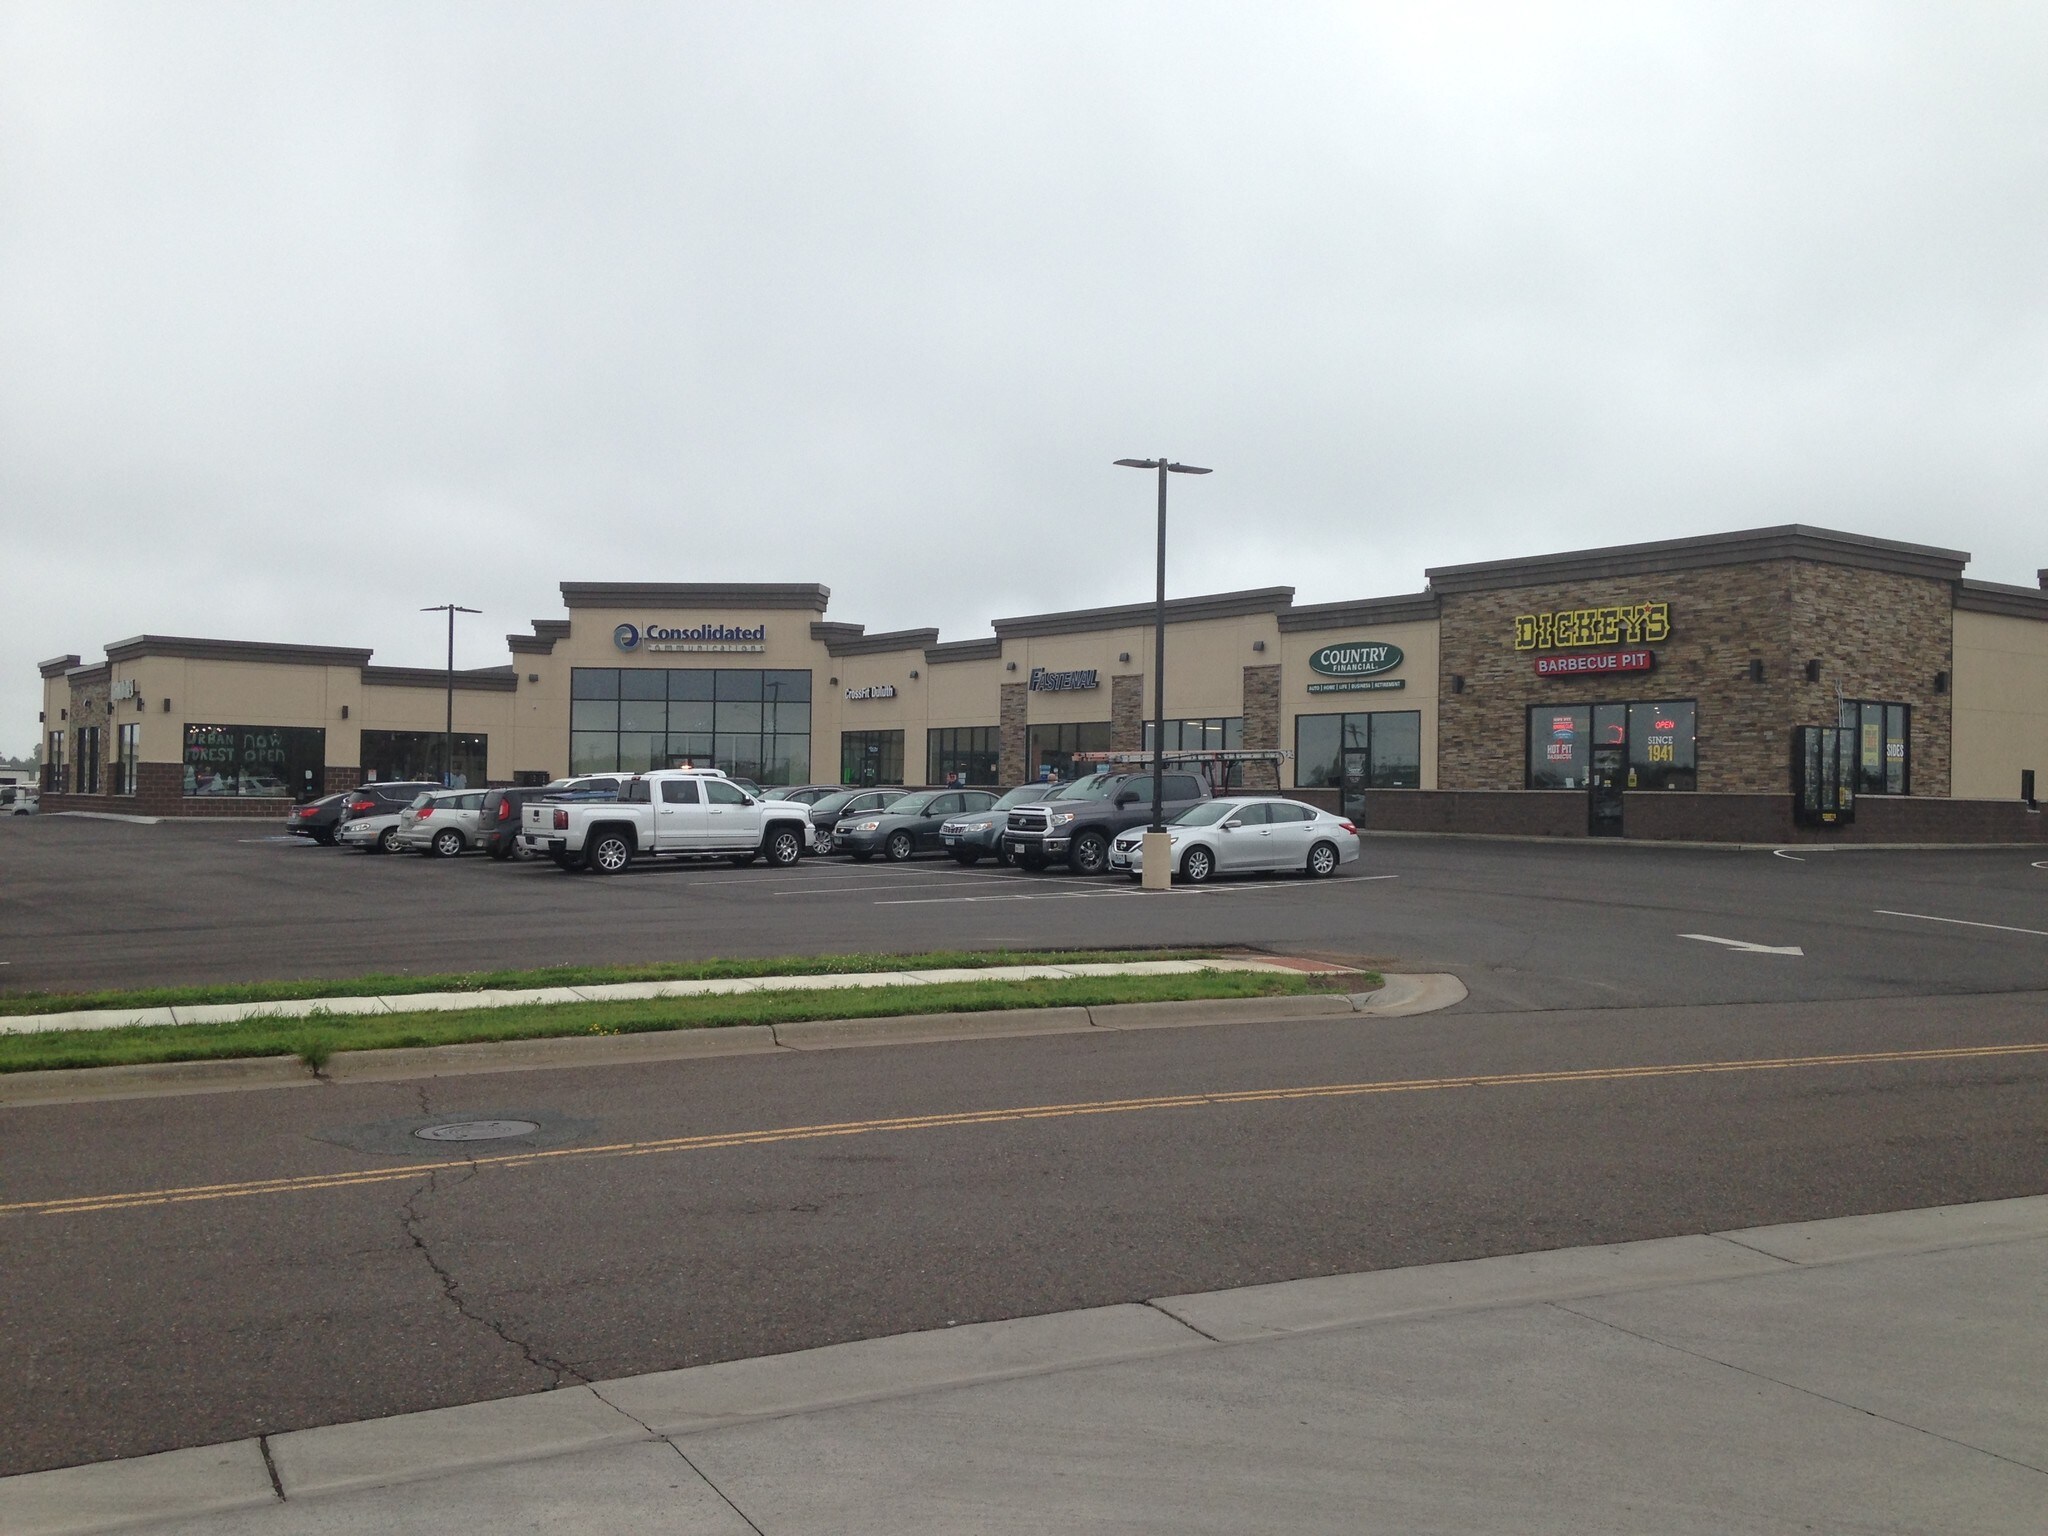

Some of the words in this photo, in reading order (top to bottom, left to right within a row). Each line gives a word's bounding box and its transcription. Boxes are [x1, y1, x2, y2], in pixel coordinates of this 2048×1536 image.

[646, 624, 765, 641] Consolidated
[1320, 647, 1388, 665] COUNTRY
[1538, 655, 1617, 672] BARBECUE
[1622, 653, 1646, 667] PIT
[1333, 664, 1376, 672] FINANCIAL
[1029, 667, 1098, 692] FASTENAL
[844, 687, 870, 700] CrossFit
[871, 685, 894, 698] Duluth
[1654, 721, 1674, 729] OPEN
[186, 733, 234, 745] URBAN
[1647, 736, 1674, 745] SINCE
[185, 748, 235, 762] FOREST
[1547, 744, 1560, 754] HOT
[1561, 744, 1573, 753] PIT
[1647, 745, 1674, 762] 1941
[1886, 743, 1904, 757] SIDES
